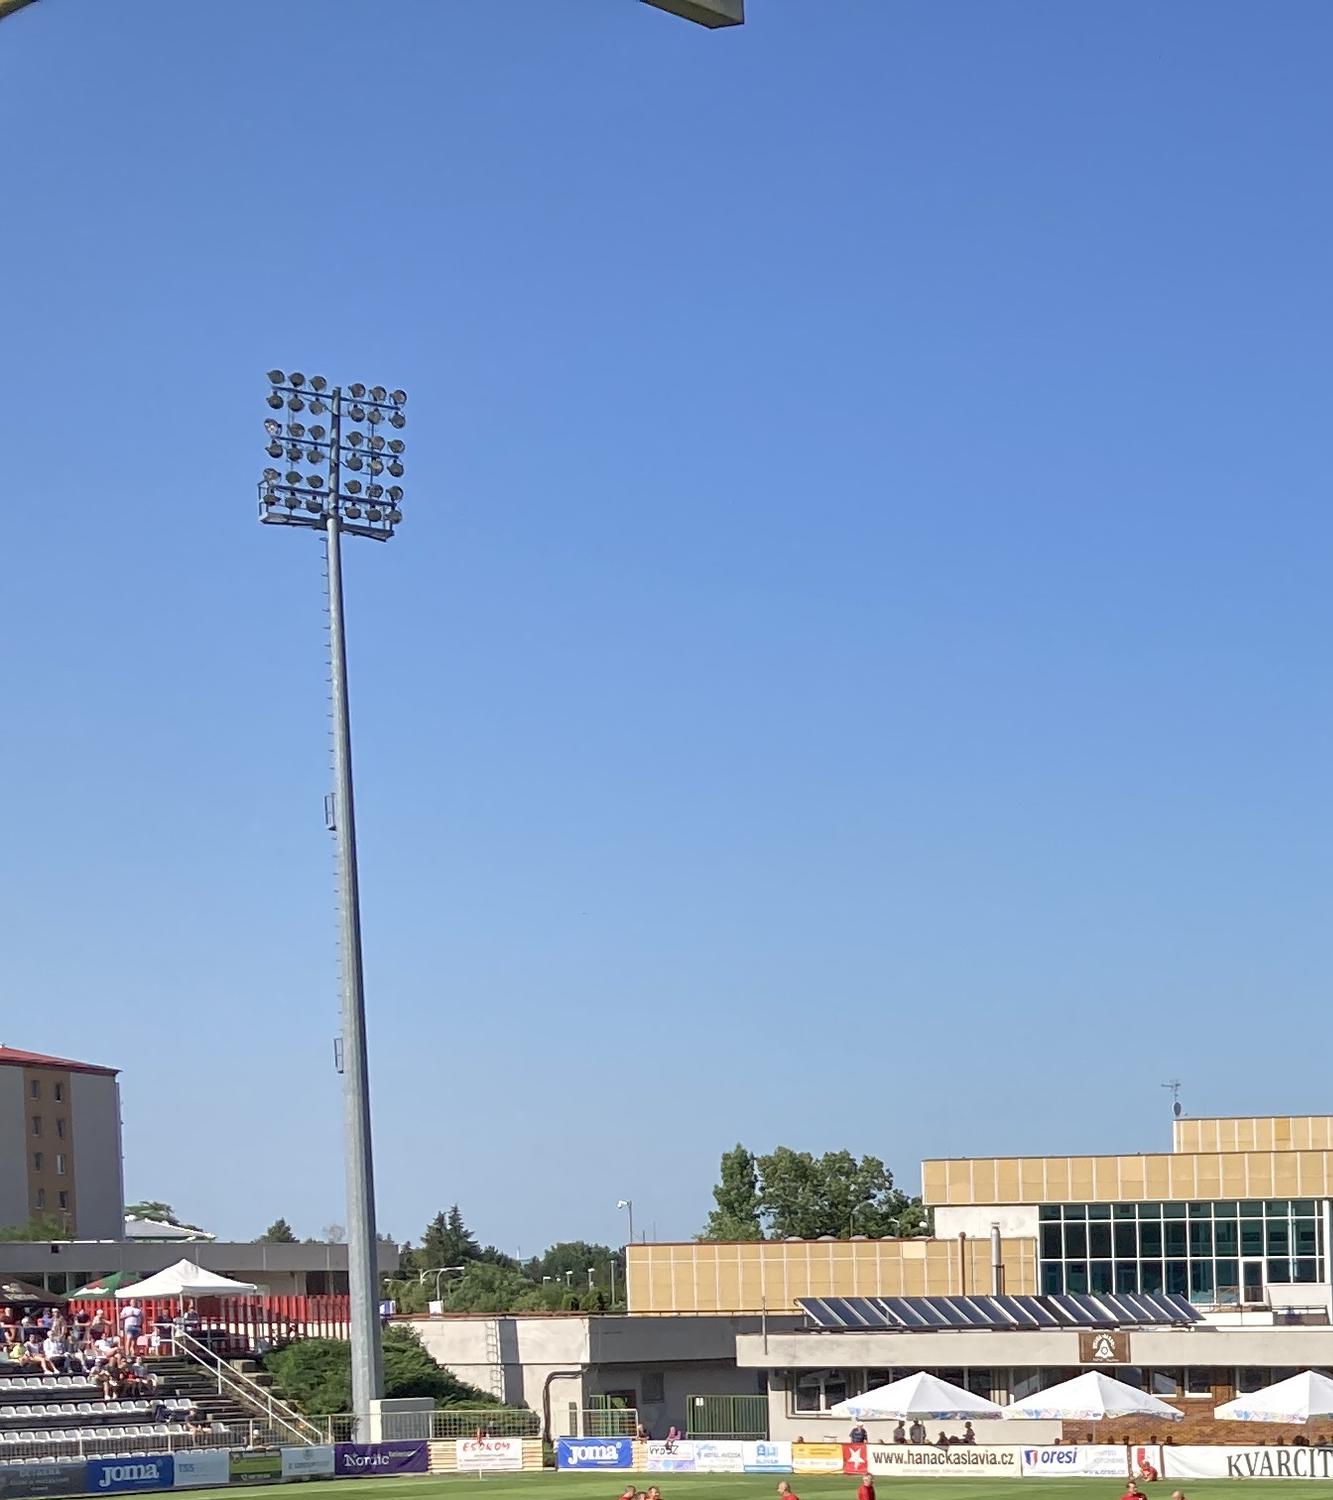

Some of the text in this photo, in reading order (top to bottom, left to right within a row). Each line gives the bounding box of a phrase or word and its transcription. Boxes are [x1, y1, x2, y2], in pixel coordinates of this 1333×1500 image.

[344, 1453, 390, 1467] Nordic
[872, 1449, 1015, 1465] www.hanackaslavia.cz
[1041, 1447, 1078, 1464] oresi
